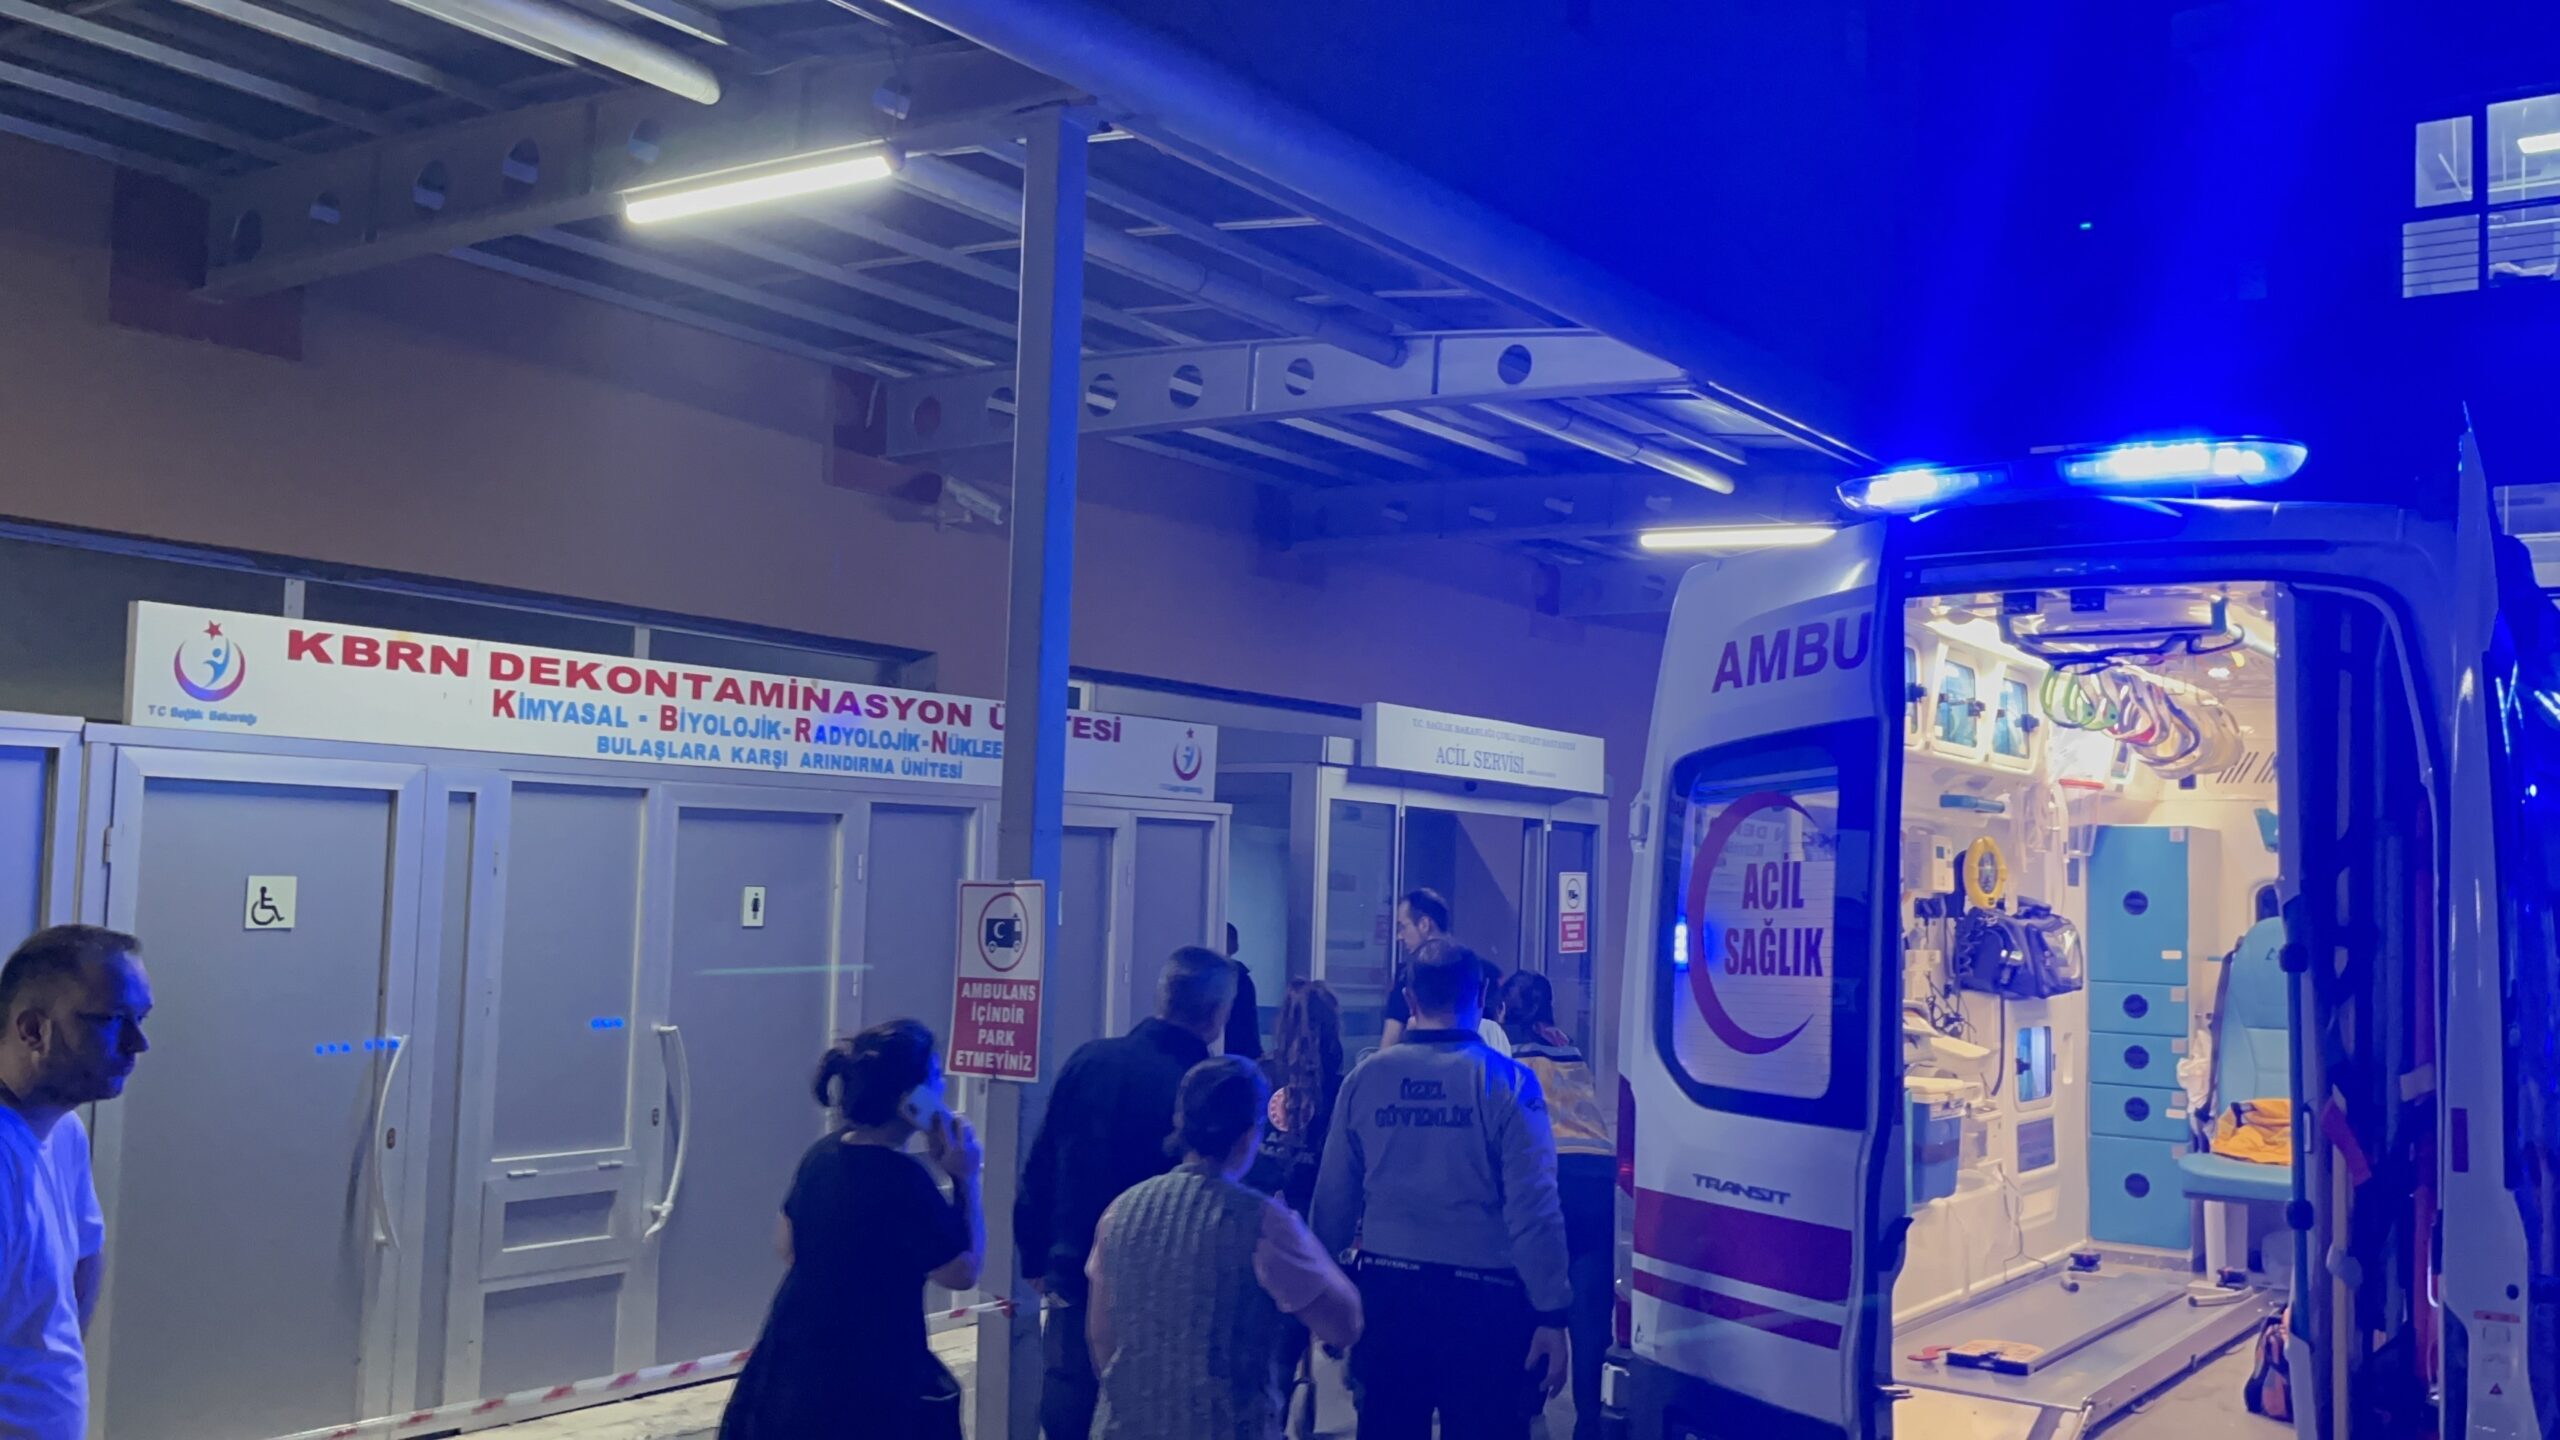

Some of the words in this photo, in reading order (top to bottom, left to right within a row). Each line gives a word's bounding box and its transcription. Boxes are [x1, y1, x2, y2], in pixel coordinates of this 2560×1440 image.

[1711, 610, 1873, 694] AMBU
[287, 629, 470, 678] KBRN
[489, 651, 973, 728] DEKONTAMİNASYON
[492, 688, 629, 729] KİMYASAL
[931, 729, 1003, 760] NÜKLEE
[596, 735, 722, 762] BULAŞLARA
[730, 746, 789, 770] KARŞI
[799, 751, 895, 775] ARINDIRMA
[901, 756, 963, 780] ÜNİTESİ
[1435, 743, 1470, 768] ACİL
[1473, 749, 1525, 775] SERVİSİ
[1742, 852, 1805, 910] ACİL
[1724, 917, 1824, 978] SAĞLIK
[961, 982, 1036, 1001] AMBULANS
[971, 1002, 1025, 1026] İÇİNDİR
[977, 1028, 1016, 1047] PARK
[955, 1049, 1033, 1072] ETMEYİNİZ
[1692, 1172, 1792, 1205] TRANSIT
